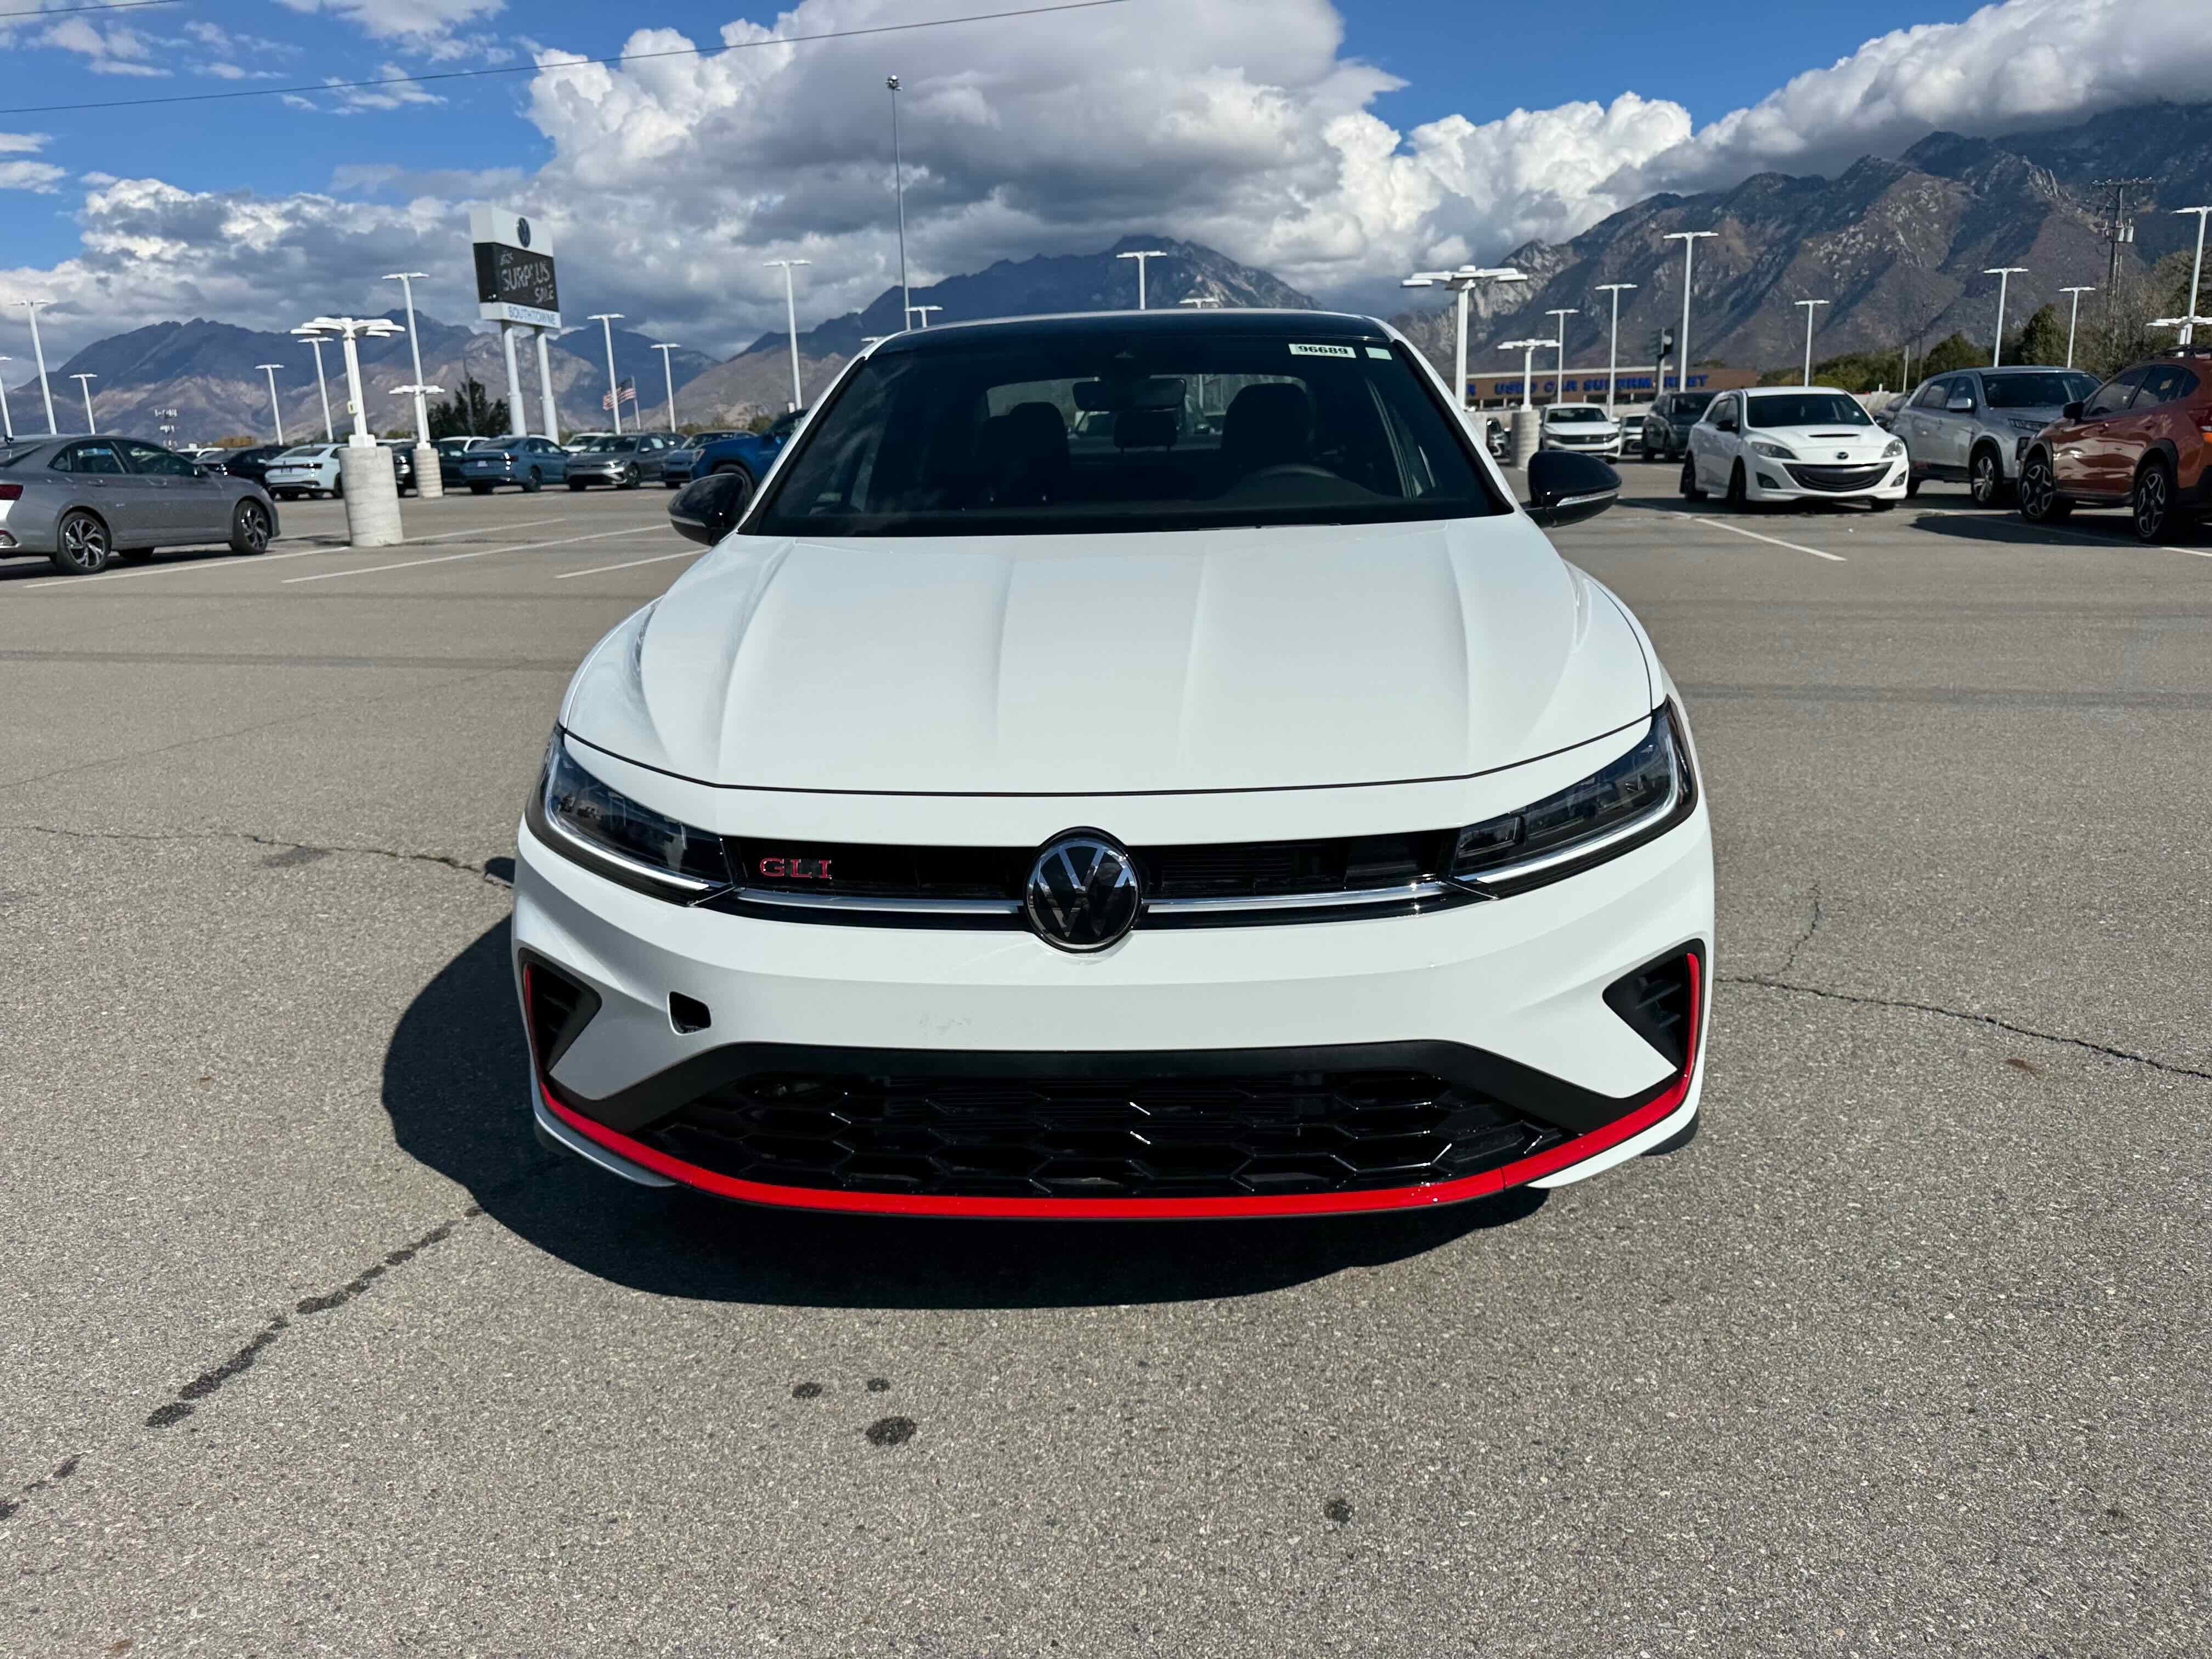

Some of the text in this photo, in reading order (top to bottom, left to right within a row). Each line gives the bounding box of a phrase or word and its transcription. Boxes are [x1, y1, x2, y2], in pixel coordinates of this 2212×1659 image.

[1298, 346, 1348, 354] 96689
[1583, 374, 1709, 392] SUERMRET
[759, 857, 832, 879] GLI
